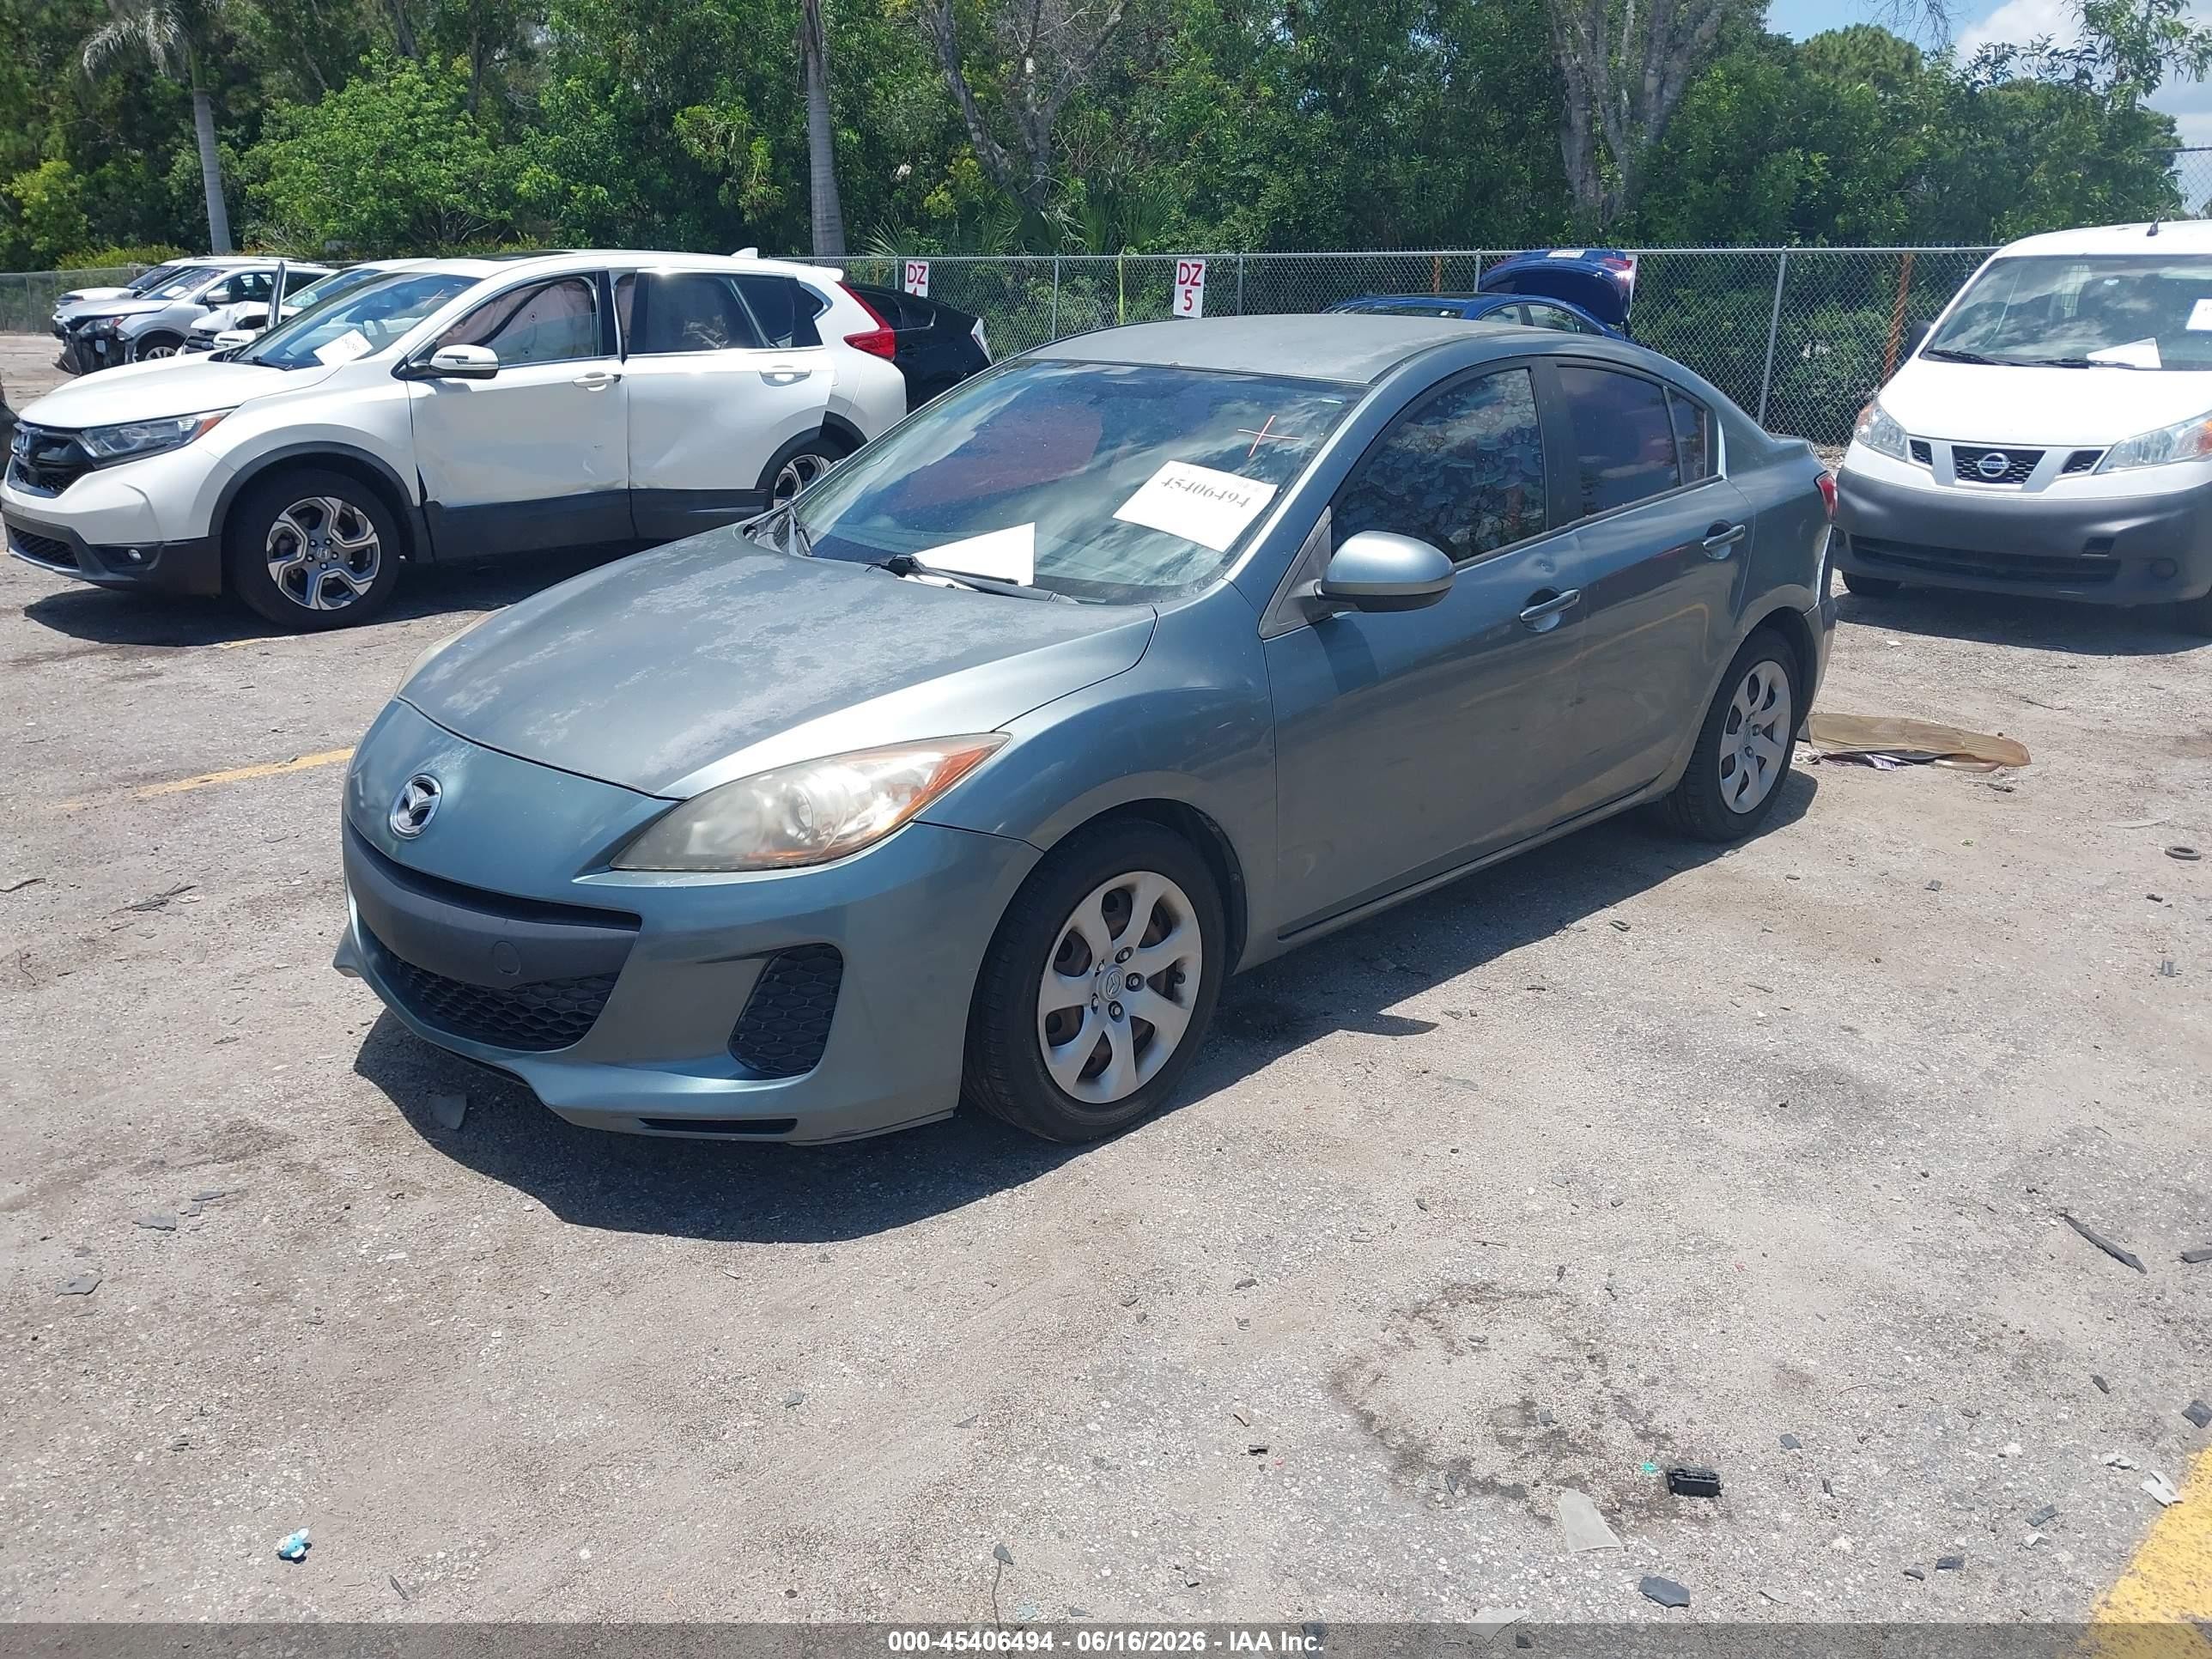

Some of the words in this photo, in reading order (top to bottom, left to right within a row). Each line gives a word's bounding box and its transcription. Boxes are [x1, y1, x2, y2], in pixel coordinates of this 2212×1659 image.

[907, 264, 927, 285] DZ
[1178, 262, 1203, 287] DZ
[1182, 289, 1193, 312] 5
[1160, 477, 1251, 507] 45406494
